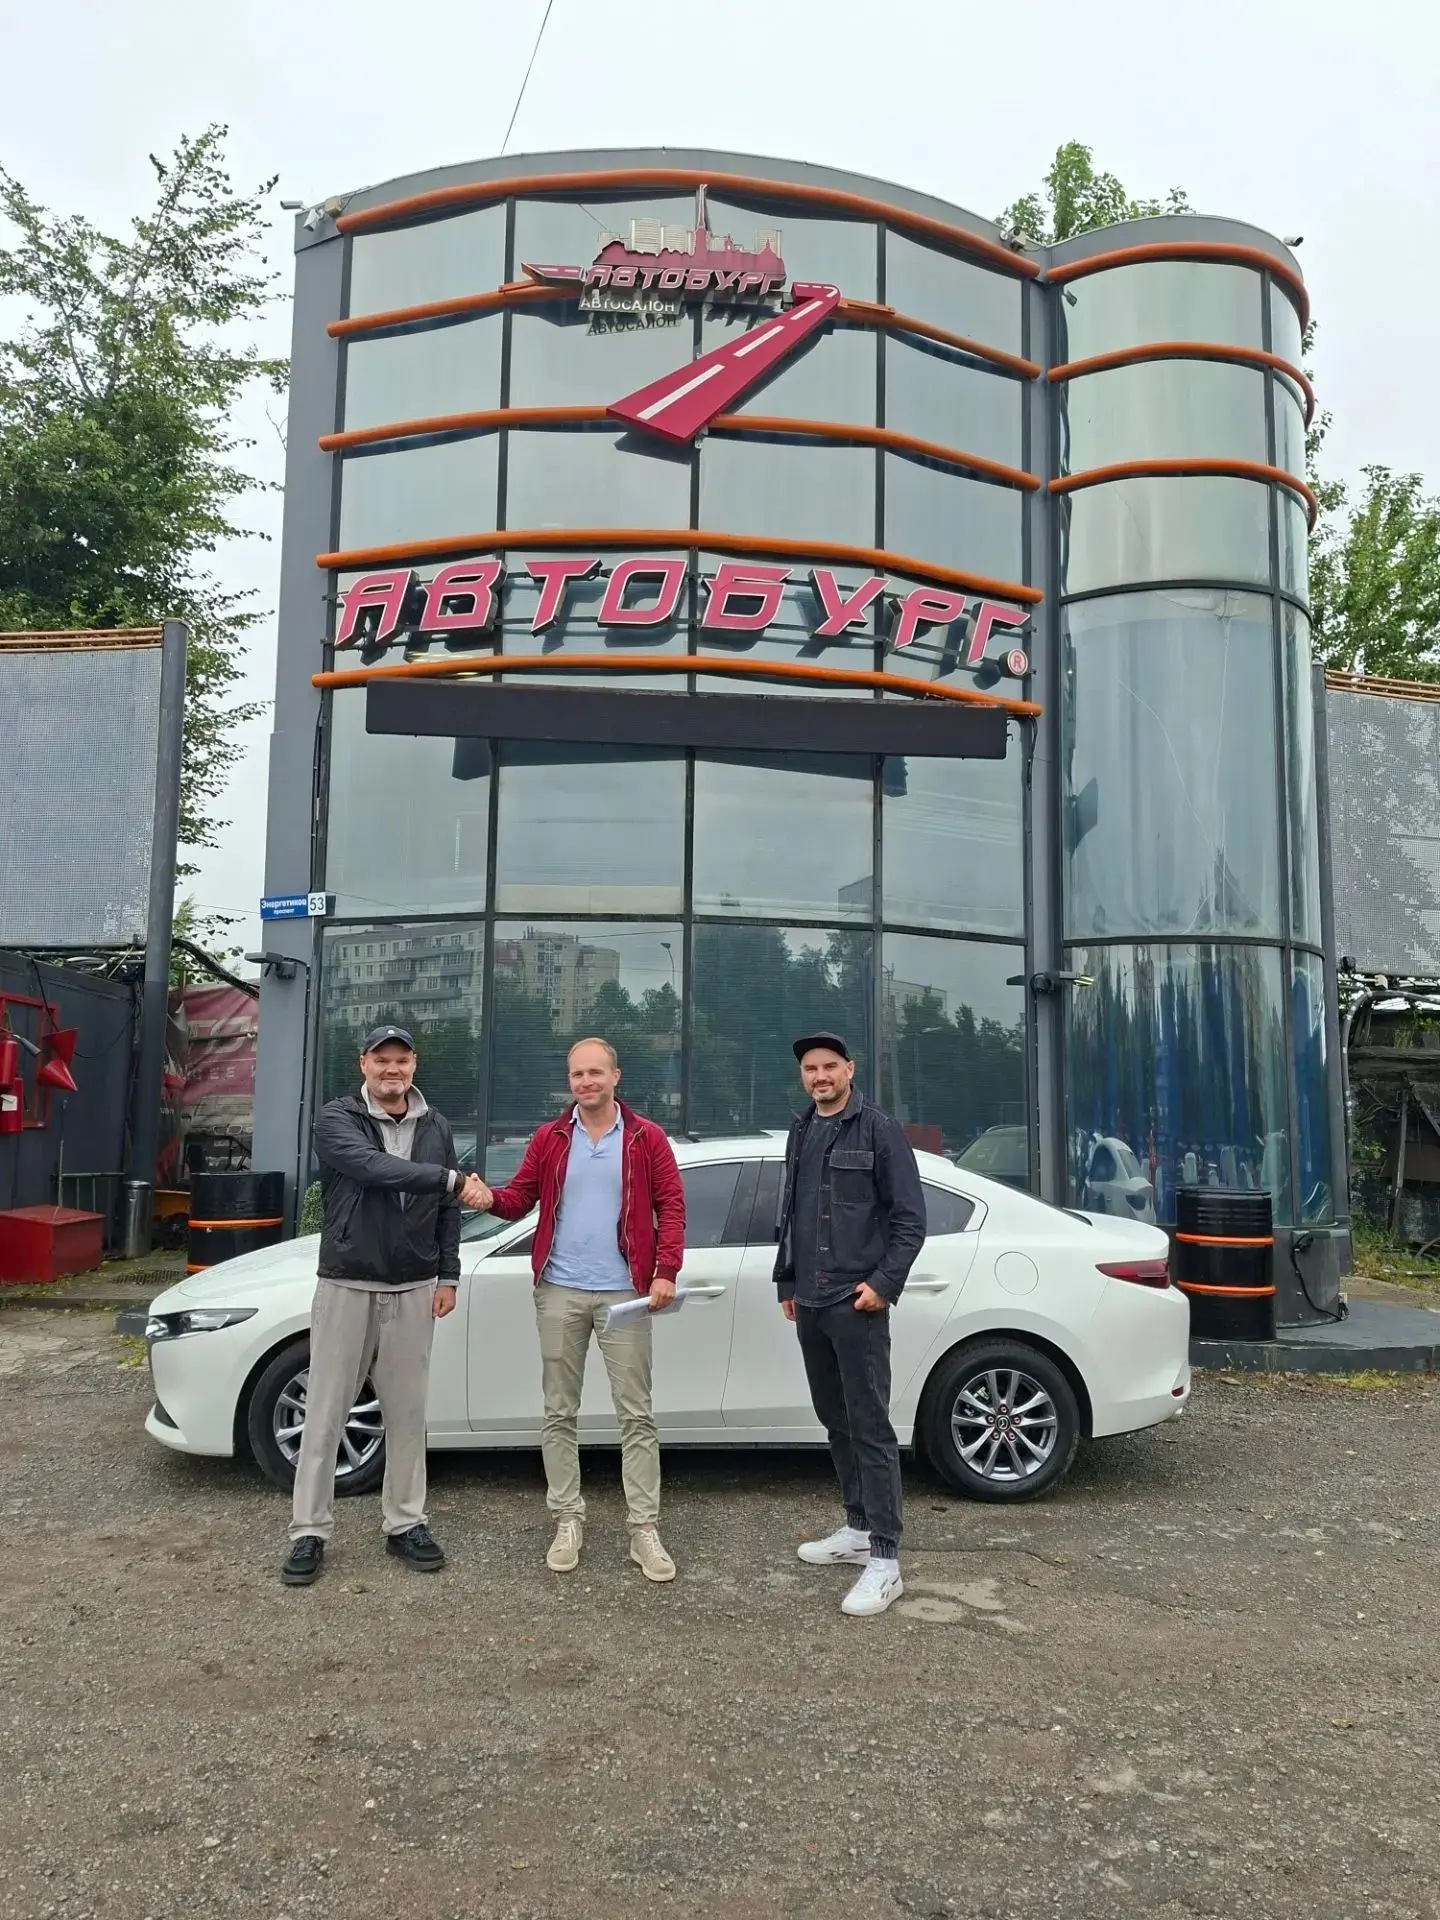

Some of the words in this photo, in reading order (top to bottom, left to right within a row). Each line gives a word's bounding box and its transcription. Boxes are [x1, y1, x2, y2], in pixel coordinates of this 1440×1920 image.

[584, 265, 786, 295] АВТОБУРГ
[580, 297, 675, 312] АВТОСАЛОН
[334, 558, 1030, 664] АВТОБУРГ
[261, 898, 307, 909] Энергетиков
[309, 896, 325, 911] 53
